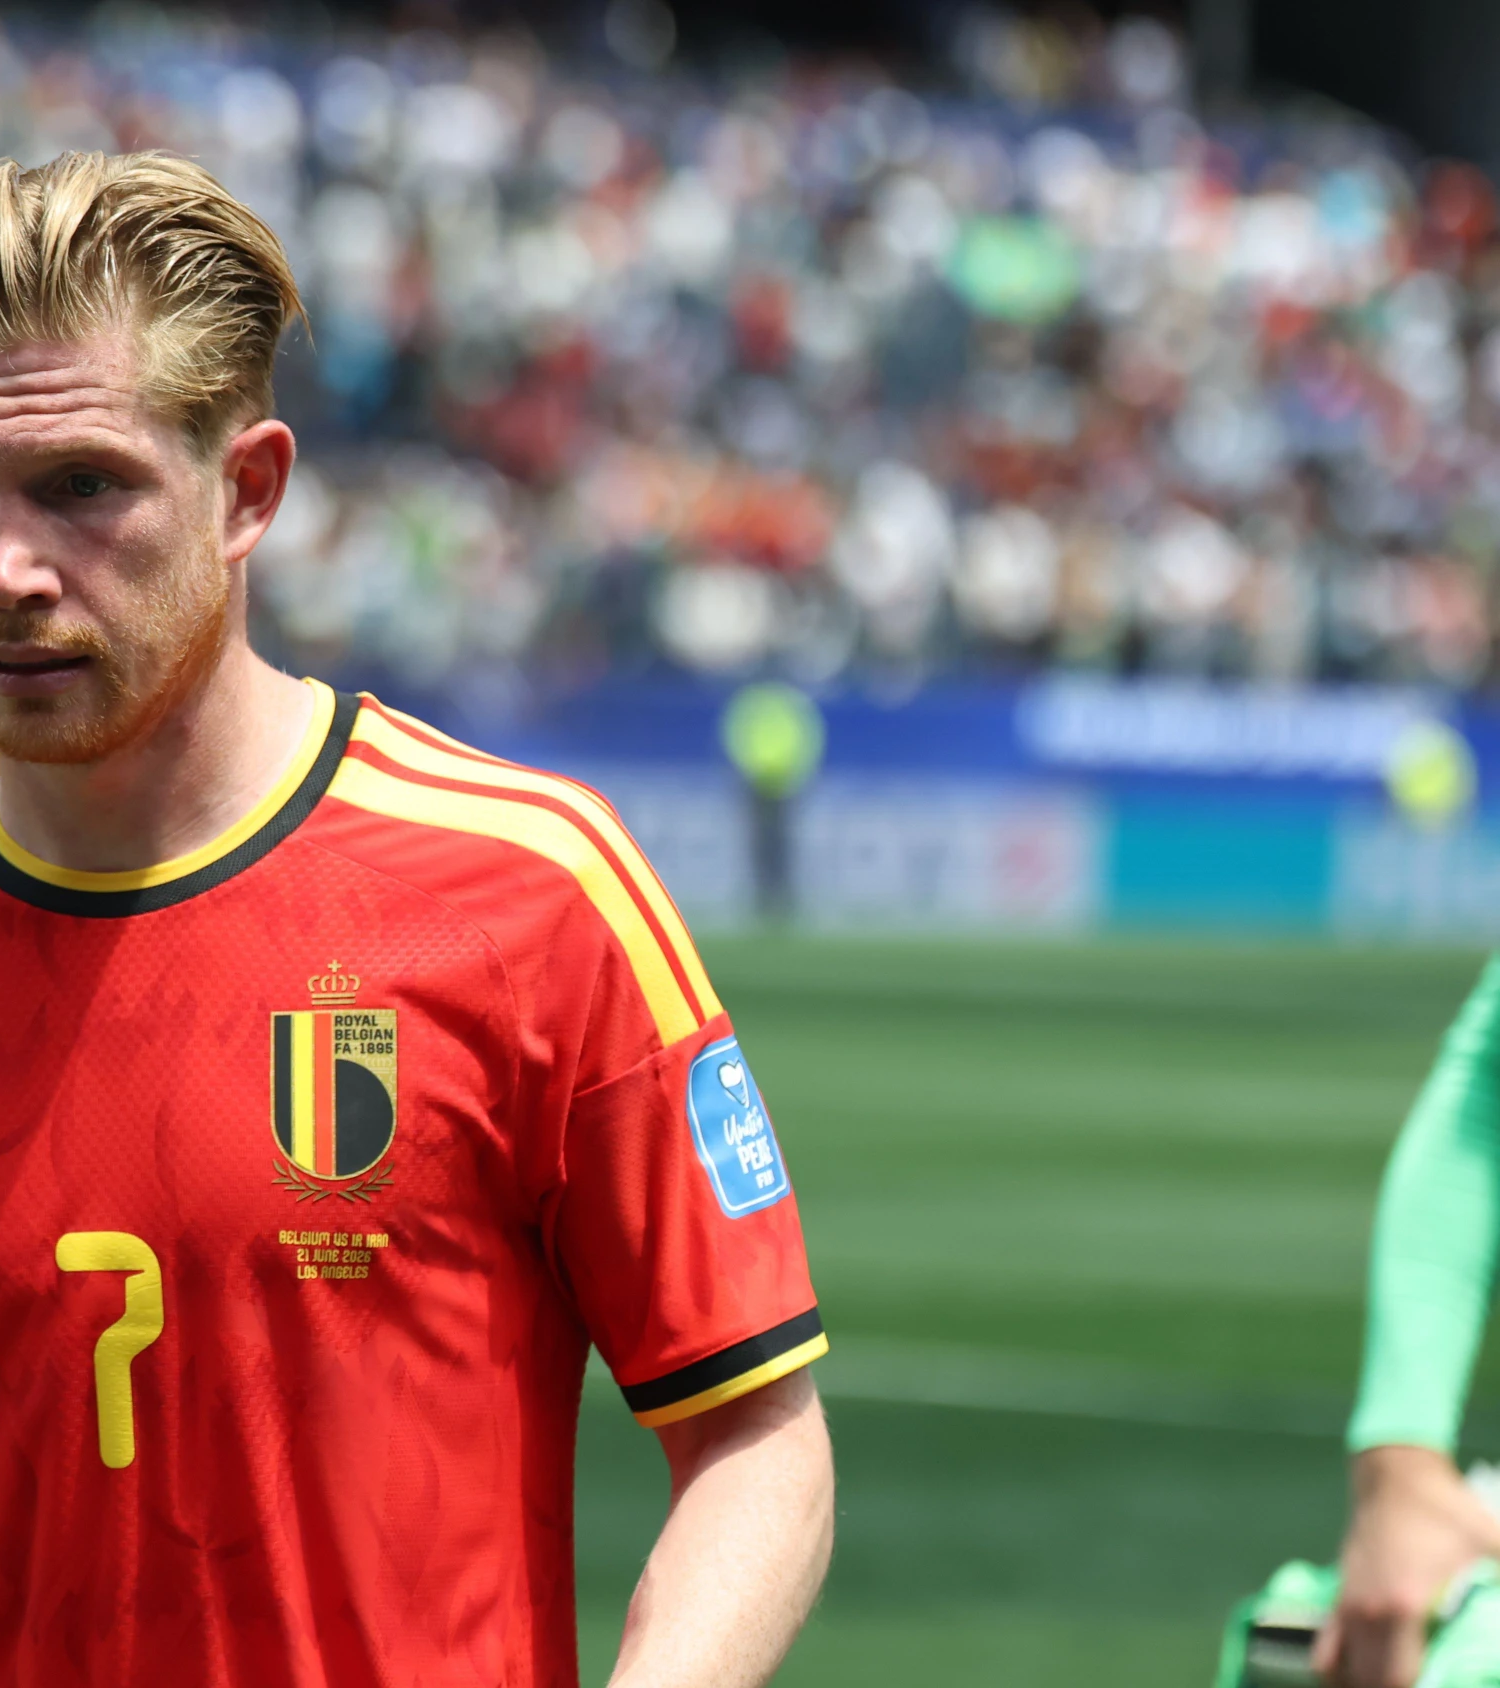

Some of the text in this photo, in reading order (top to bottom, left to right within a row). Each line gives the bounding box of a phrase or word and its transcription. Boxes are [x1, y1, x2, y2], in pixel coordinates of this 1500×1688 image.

[334, 1015, 379, 1027] ROYAL
[334, 1028, 393, 1040] BELGIAN
[334, 1042, 393, 1054] FA 1895
[278, 1229, 330, 1246] BELGIUM
[366, 1233, 389, 1248] IRAN
[296, 1248, 372, 1263] 21 JUNE 2026
[297, 1264, 369, 1280] LOS ANGELES
[55, 1231, 164, 1468] 7
